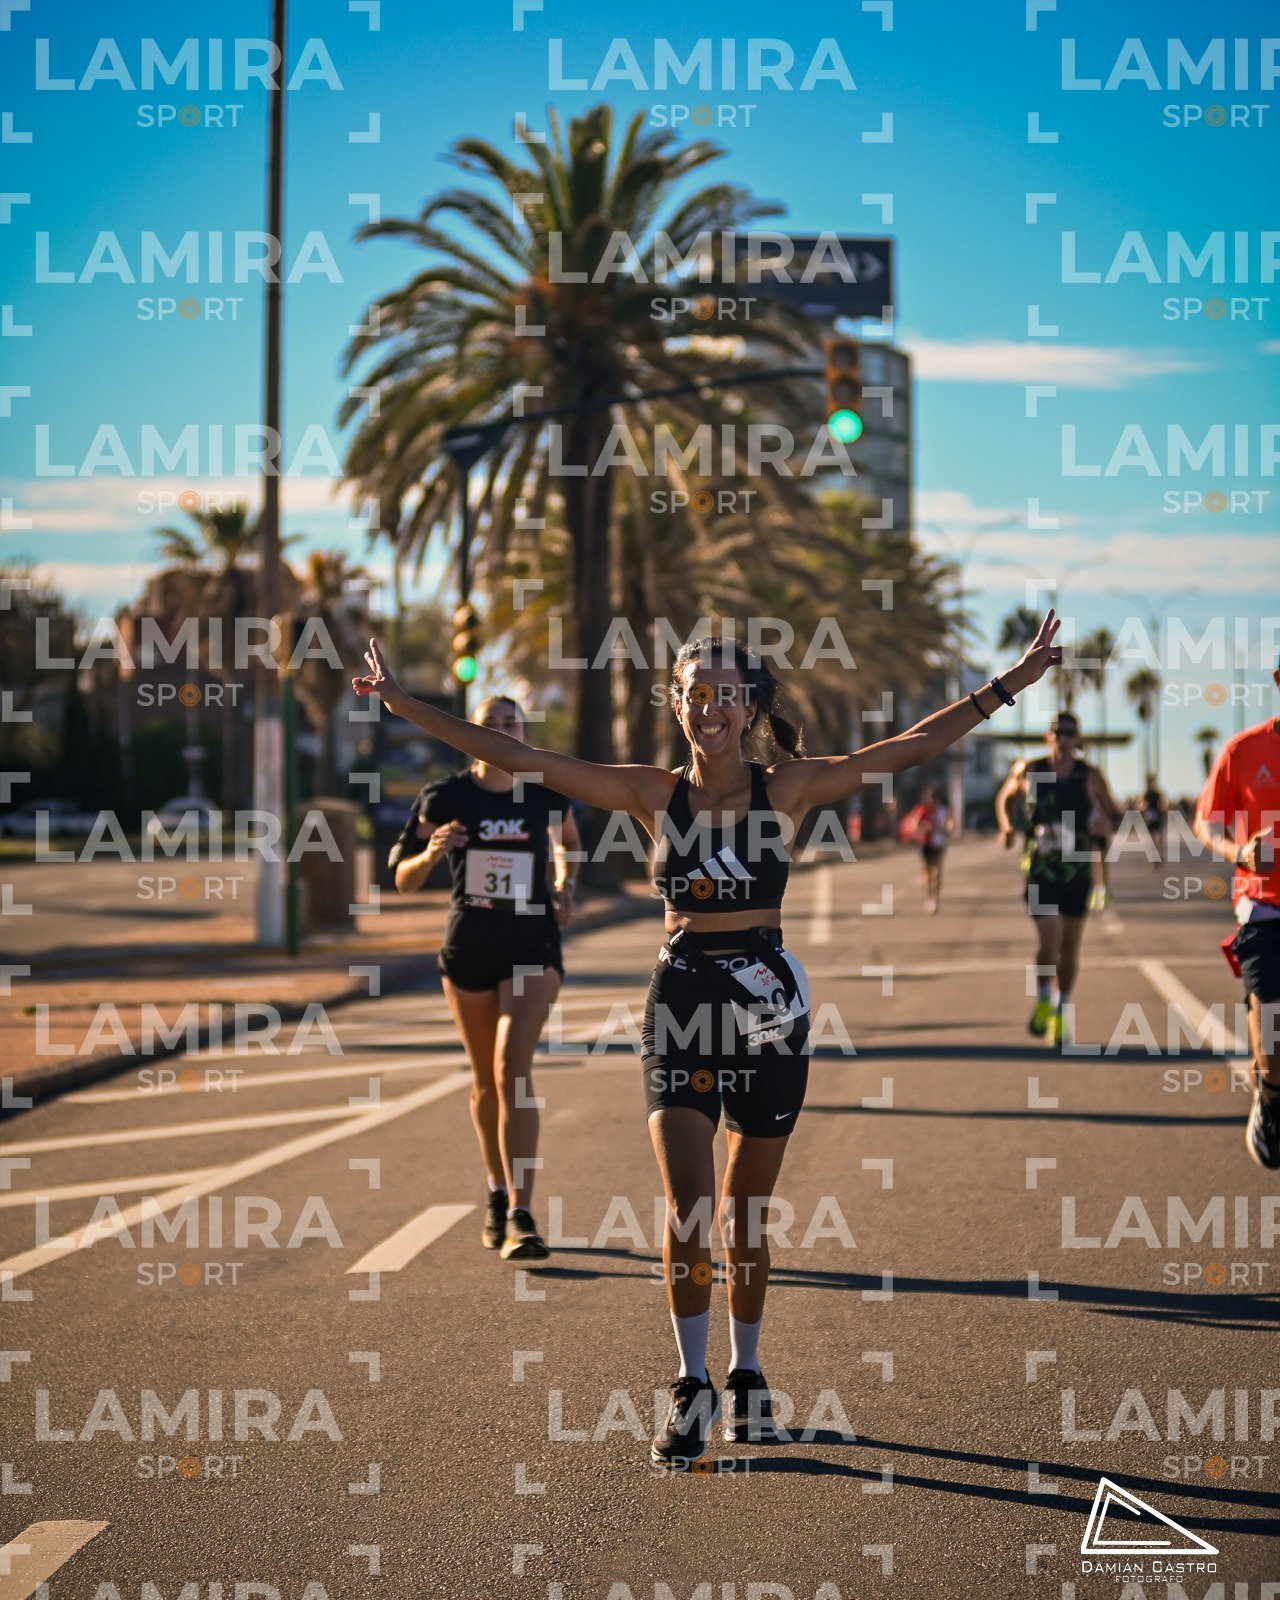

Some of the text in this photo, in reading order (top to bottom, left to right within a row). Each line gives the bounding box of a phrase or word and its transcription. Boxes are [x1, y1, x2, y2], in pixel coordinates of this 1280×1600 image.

[479, 818, 525, 841] 30K
[484, 872, 512, 895] 31
[748, 1027, 780, 1047] 30K
